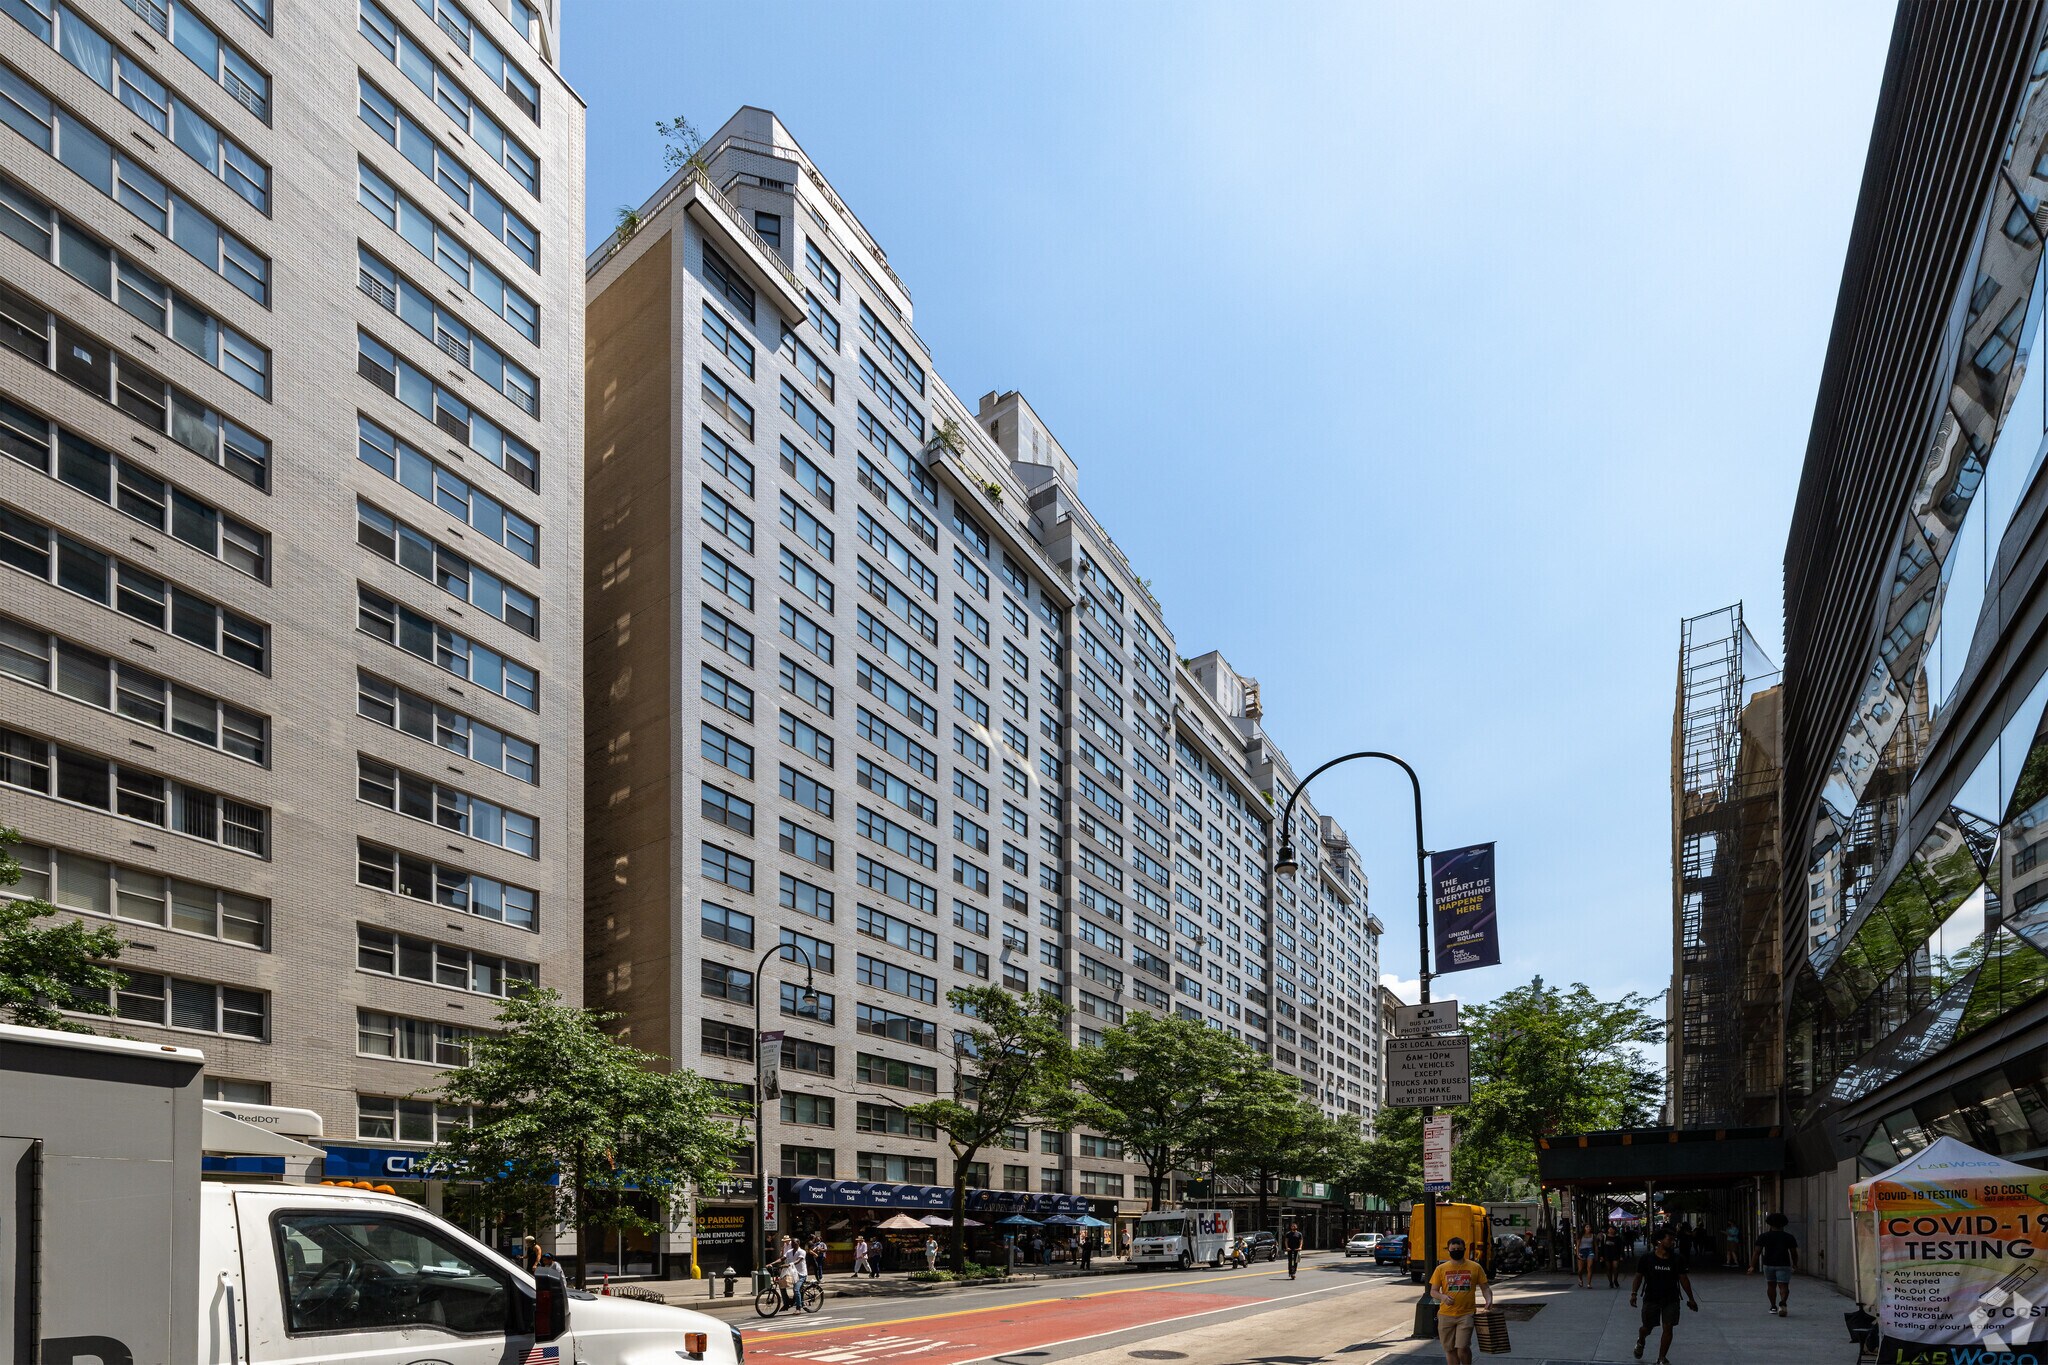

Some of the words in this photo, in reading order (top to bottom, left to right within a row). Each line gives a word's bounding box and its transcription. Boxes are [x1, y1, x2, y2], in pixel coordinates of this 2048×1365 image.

[1440, 878, 1458, 888] THE
[1444, 881, 1474, 895] HEART
[1476, 878, 1490, 887] OF
[1435, 886, 1491, 905] EVERYTHING
[1439, 895, 1484, 911] HAPPENS
[1456, 904, 1482, 915] HERE
[1448, 929, 1470, 939] UNION
[1457, 932, 1484, 942] SQUARE
[1419, 1061, 1455, 1069] VEHICLES
[1414, 1070, 1443, 1078] EXCEPT
[237, 1114, 280, 1124] RedDOT
[387, 1156, 484, 1175] CHAS
[1878, 1190, 1924, 1201] COVID-19
[1926, 1189, 1968, 1200] TESTING
[2000, 1183, 2029, 1195] COST
[765, 1186, 775, 1220] PARK
[708, 1216, 745, 1224] PARKING
[1198, 1213, 1229, 1234] FedEx
[1905, 1239, 2035, 1260] TESTING
[1895, 1294, 1927, 1302] Pocket
[1912, 1312, 1953, 1320] PROBLEM
[1894, 1322, 1925, 1331] Testing
